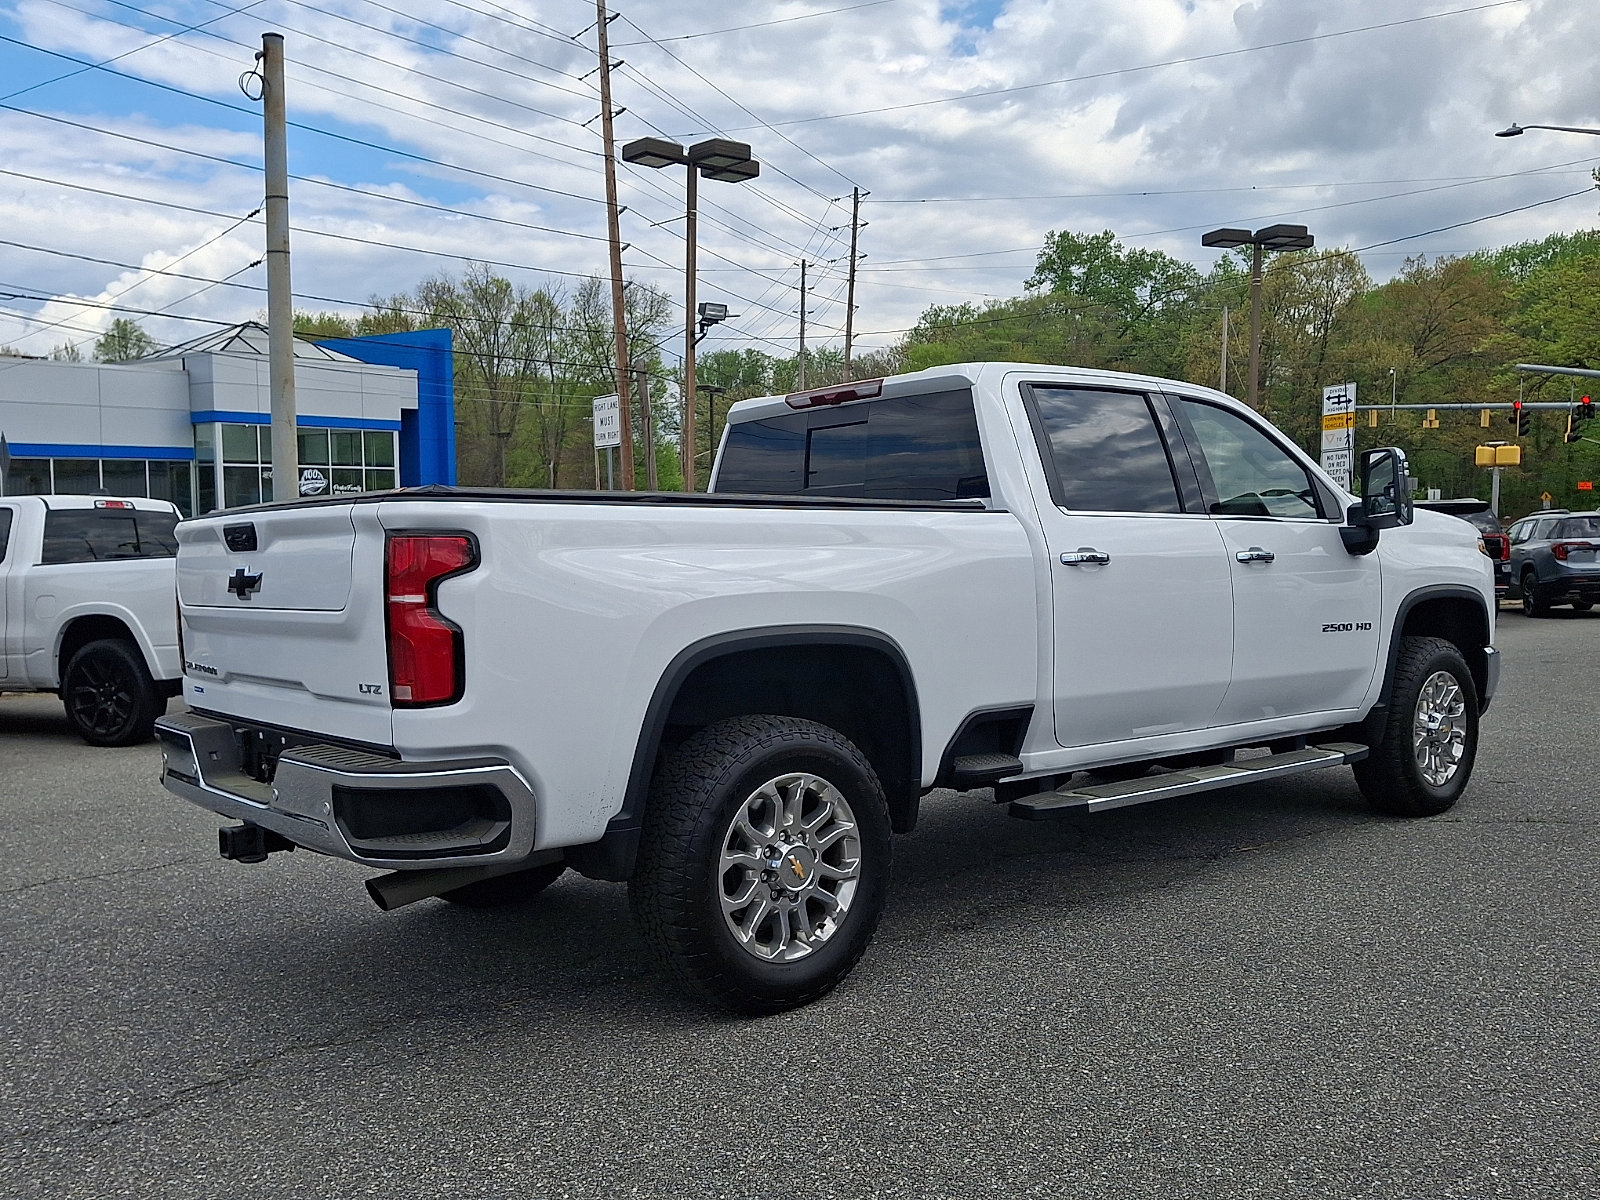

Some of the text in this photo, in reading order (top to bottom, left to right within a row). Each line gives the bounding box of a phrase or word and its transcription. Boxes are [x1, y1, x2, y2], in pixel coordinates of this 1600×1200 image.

[594, 401, 619, 412] RIGHT LANE
[599, 416, 614, 427] MUST
[595, 431, 619, 441] TURN RIGHT
[1322, 622, 1372, 633] 2500 HD
[358, 683, 383, 694] LTZ
